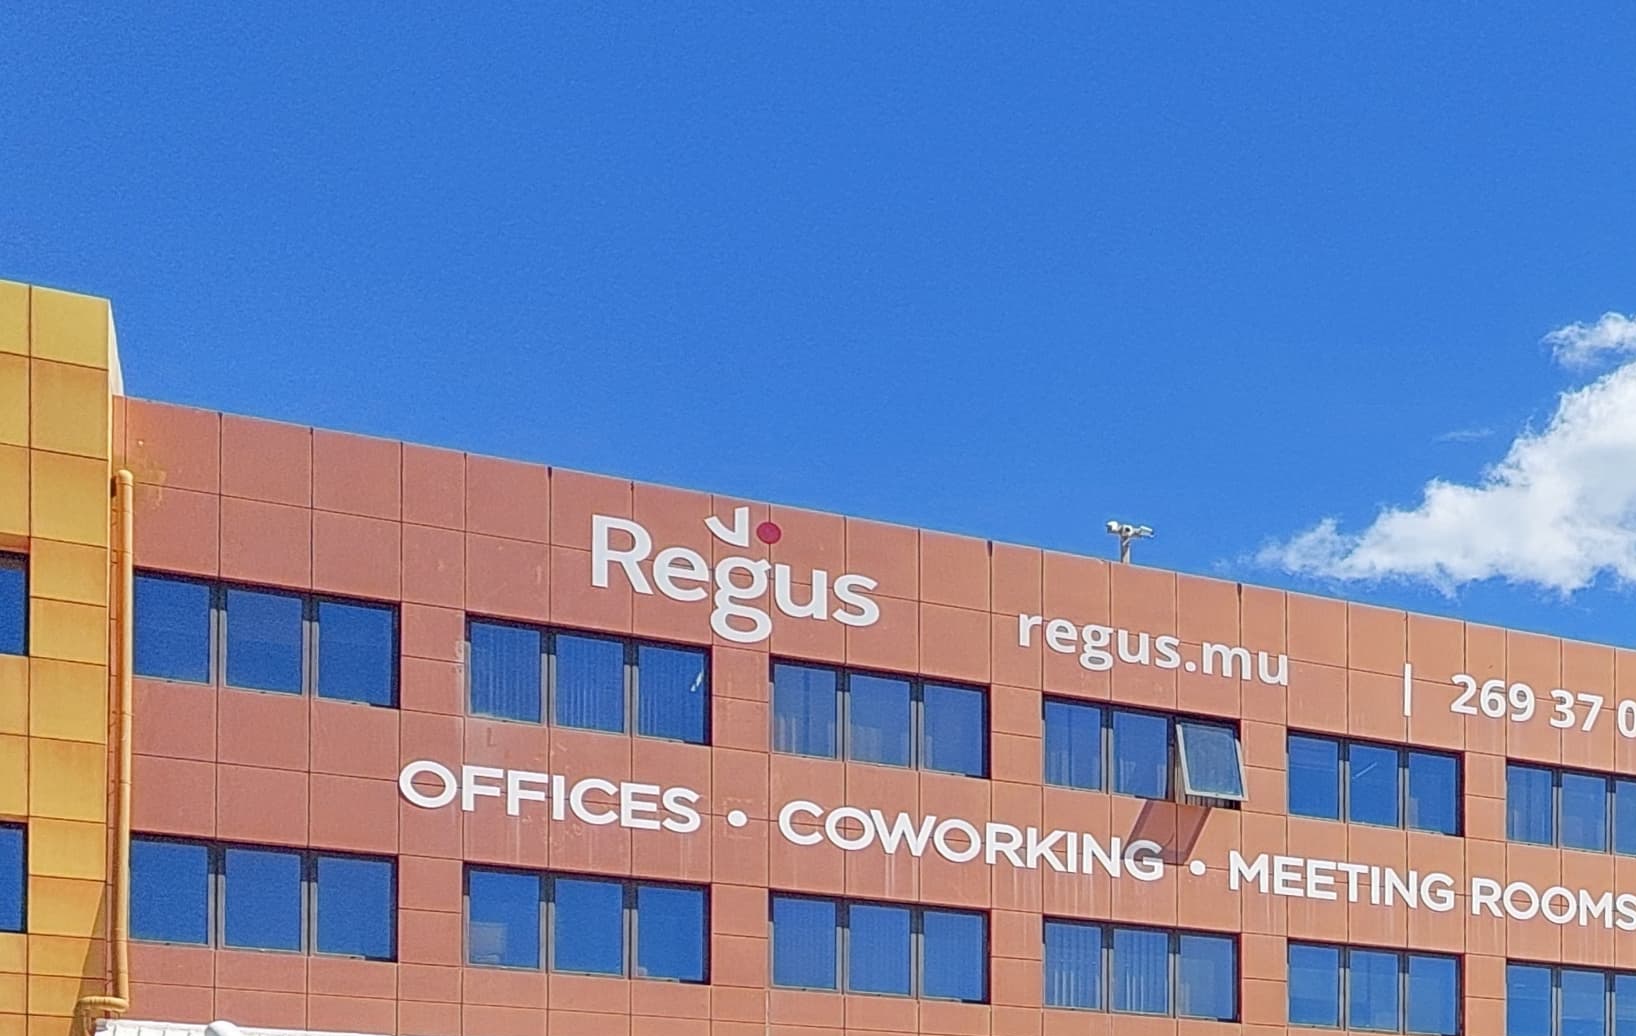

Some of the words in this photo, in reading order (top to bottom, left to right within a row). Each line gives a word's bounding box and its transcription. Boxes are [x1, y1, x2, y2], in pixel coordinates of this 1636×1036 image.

[591, 508, 881, 644] Regus
[1018, 612, 1289, 687] regus.mu
[1449, 673, 1536, 724] 269
[1548, 689, 1605, 732] 37
[398, 760, 702, 834] OFFICES
[778, 800, 1165, 882] COWORKING
[1228, 849, 1456, 914] MEETING
